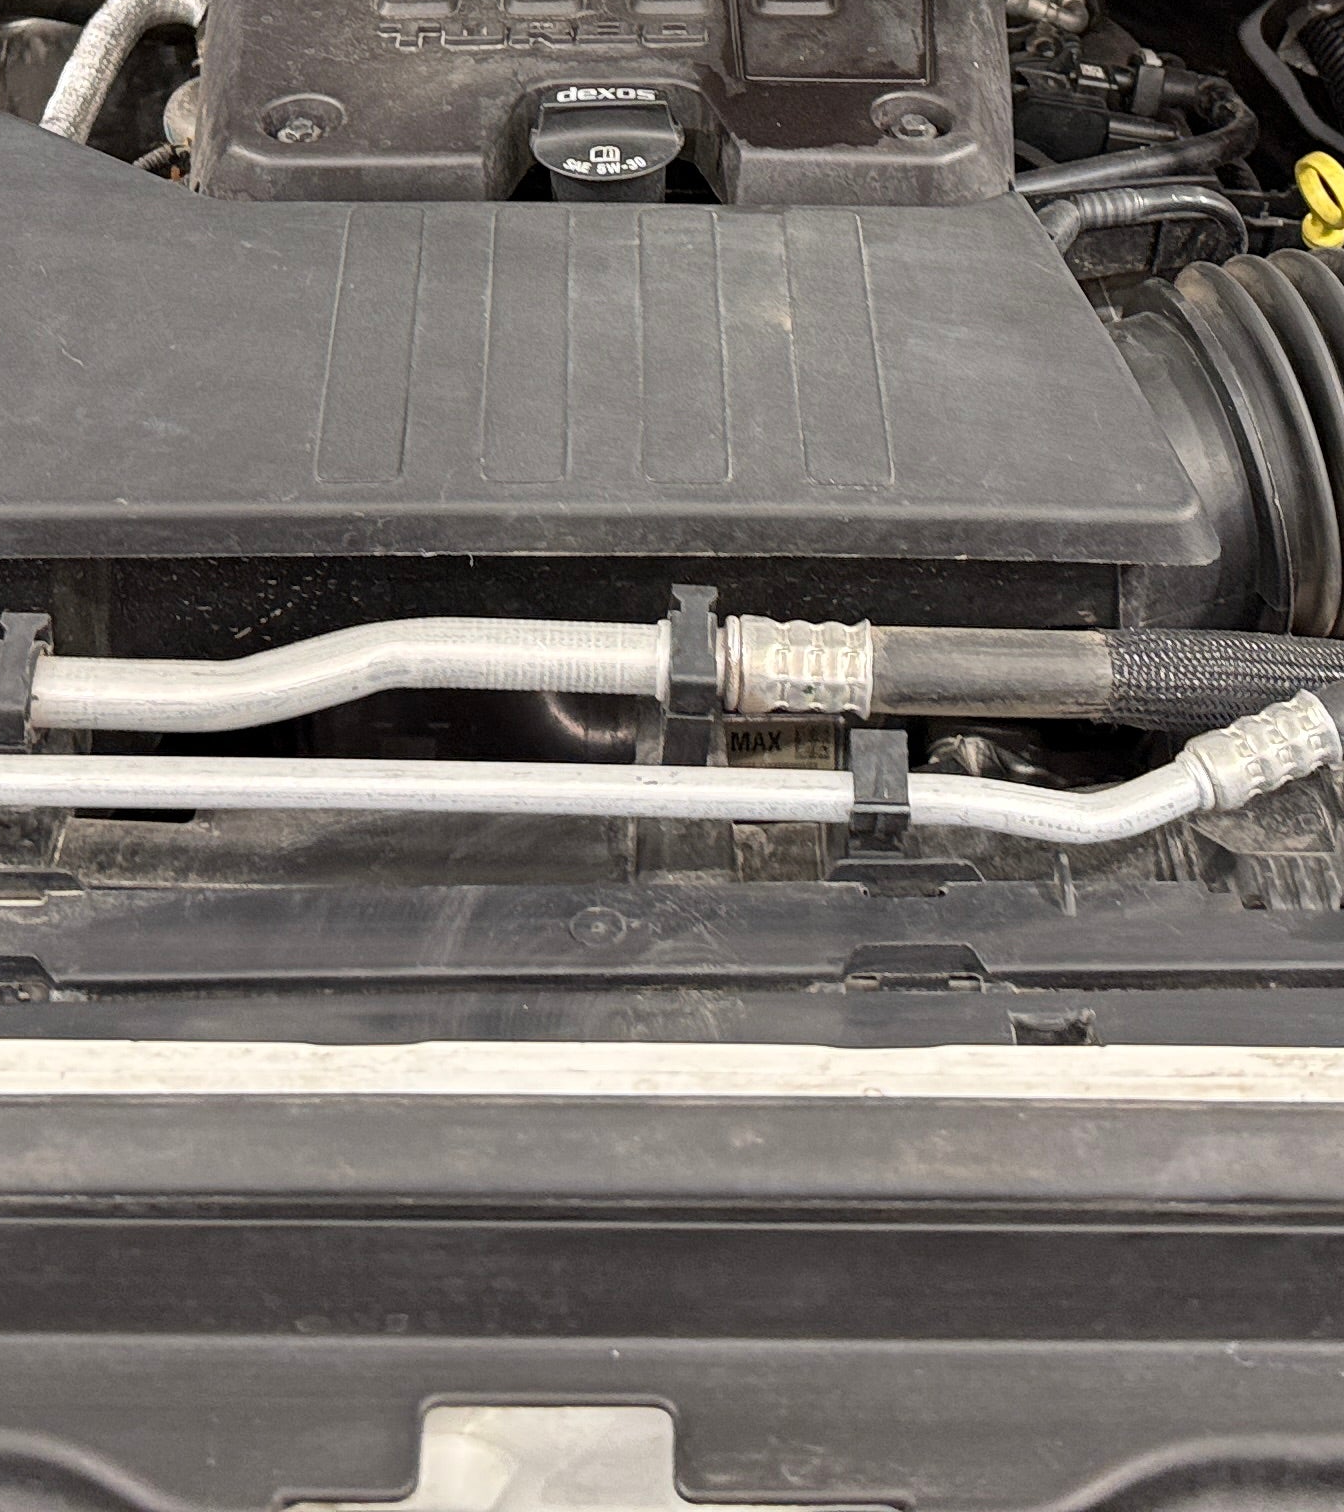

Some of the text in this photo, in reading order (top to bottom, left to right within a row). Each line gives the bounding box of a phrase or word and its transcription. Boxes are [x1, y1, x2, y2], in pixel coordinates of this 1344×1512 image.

[377, 22, 708, 52] TURBO
[556, 86, 656, 103] dexos
[562, 156, 647, 175] SAE 5W-30
[730, 730, 782, 753] MAX
